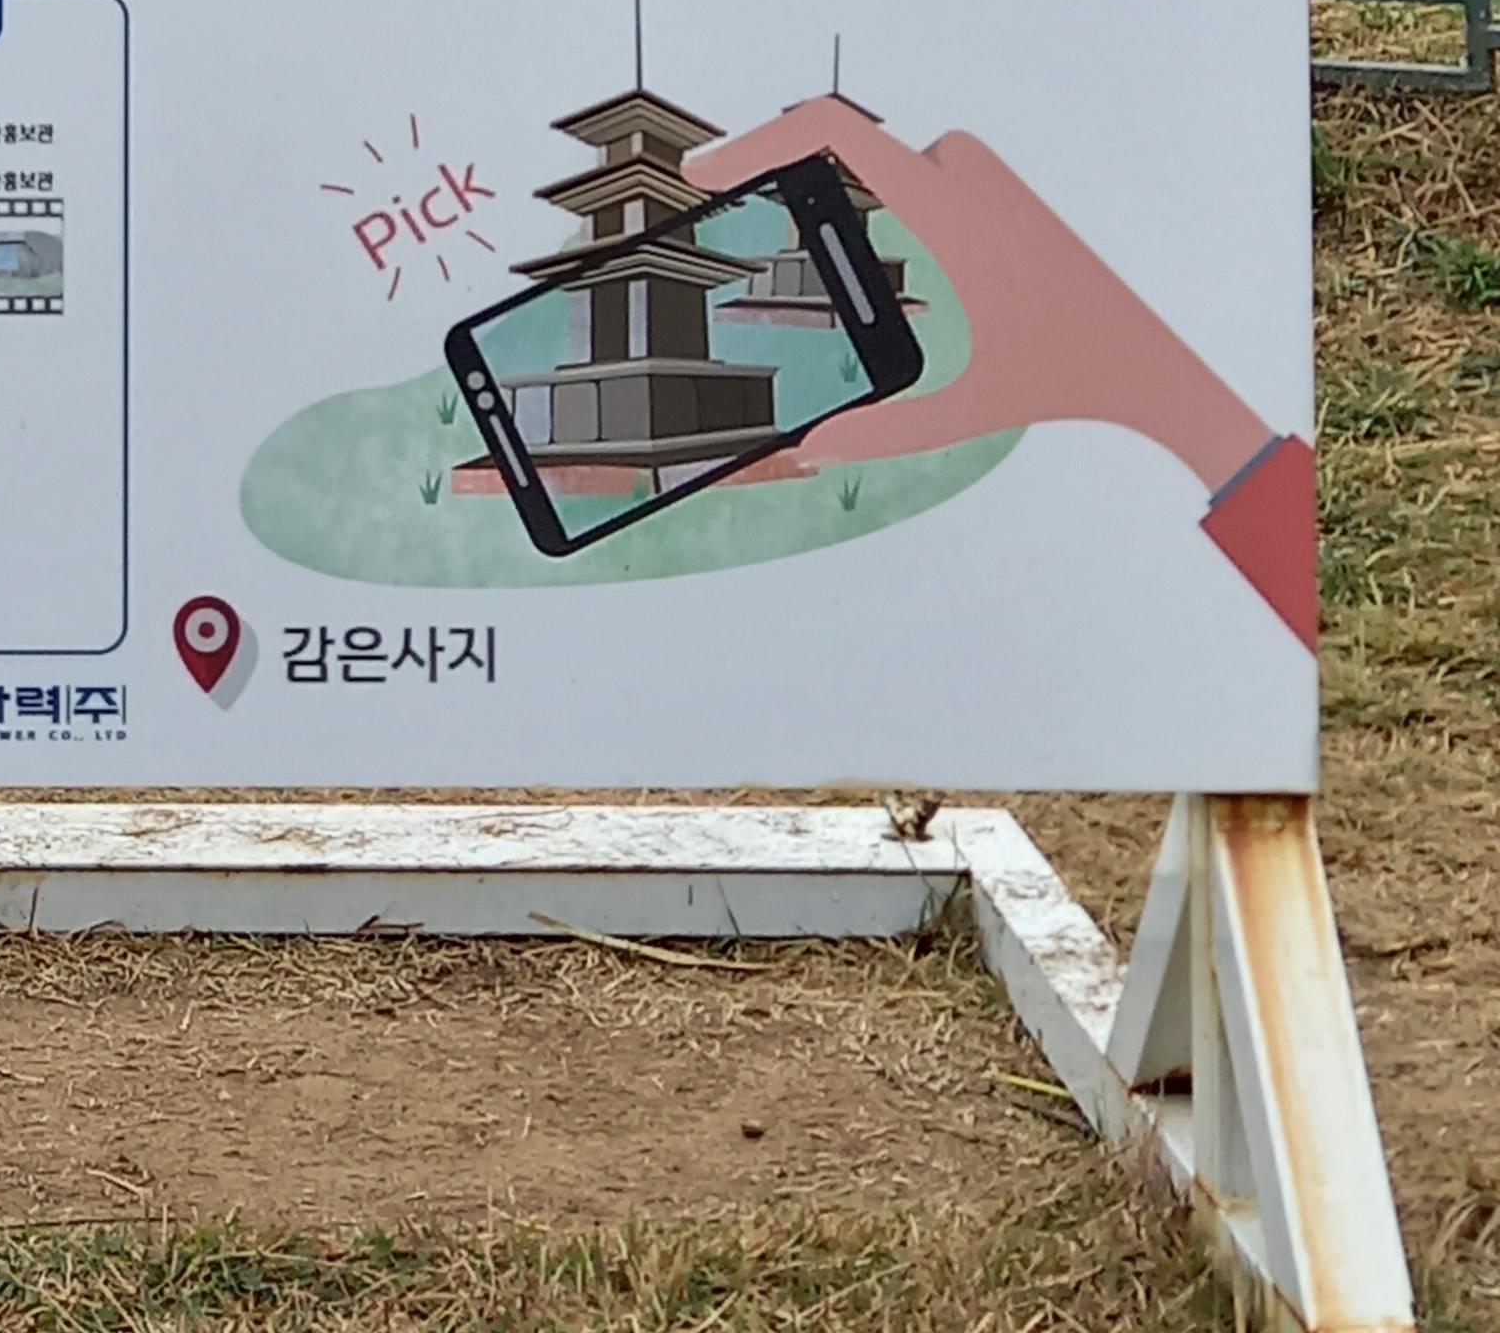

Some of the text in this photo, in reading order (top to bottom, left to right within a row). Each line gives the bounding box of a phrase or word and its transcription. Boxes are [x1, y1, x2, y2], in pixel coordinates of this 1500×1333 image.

[352, 156, 498, 271] Pick
[281, 624, 498, 684] 감은사지
[95, 730, 127, 741] LTD
